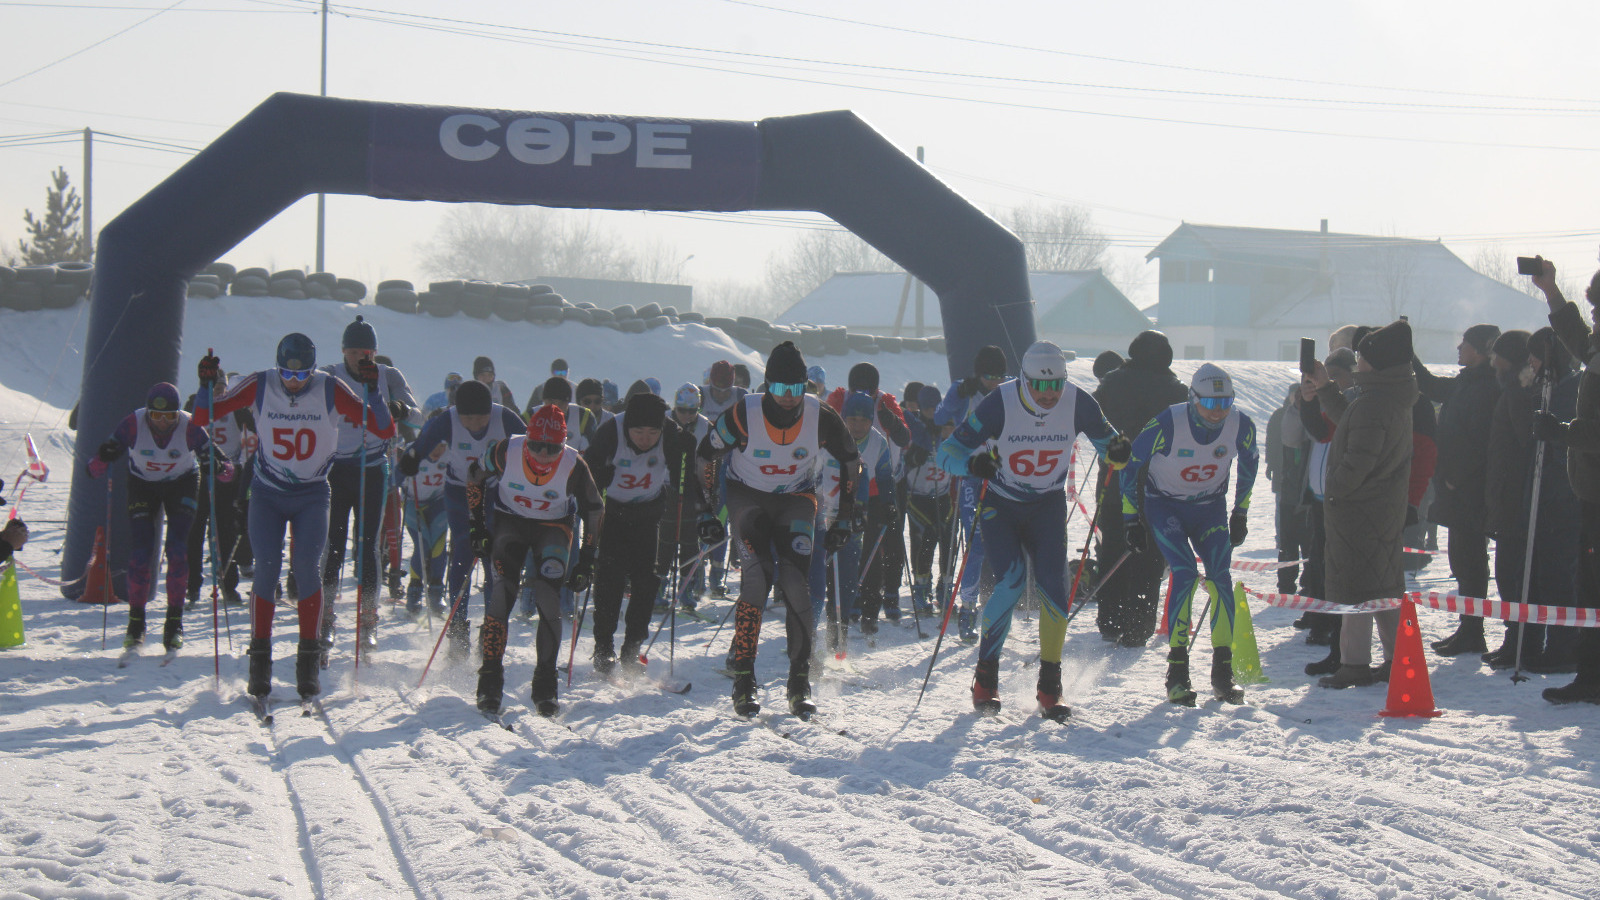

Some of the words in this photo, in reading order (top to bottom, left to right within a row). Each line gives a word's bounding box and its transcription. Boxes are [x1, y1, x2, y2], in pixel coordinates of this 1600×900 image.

[439, 114, 692, 169] СӨРЕ
[268, 411, 321, 421] ҚАРҚАРАЛЫ
[272, 427, 316, 461] 50
[1008, 434, 1068, 444] ҚАРҚАРАЛЫ
[146, 461, 177, 472] 57
[1009, 449, 1063, 477] 65
[617, 472, 653, 489] 34
[925, 467, 945, 481] 23
[1180, 464, 1218, 482] 63
